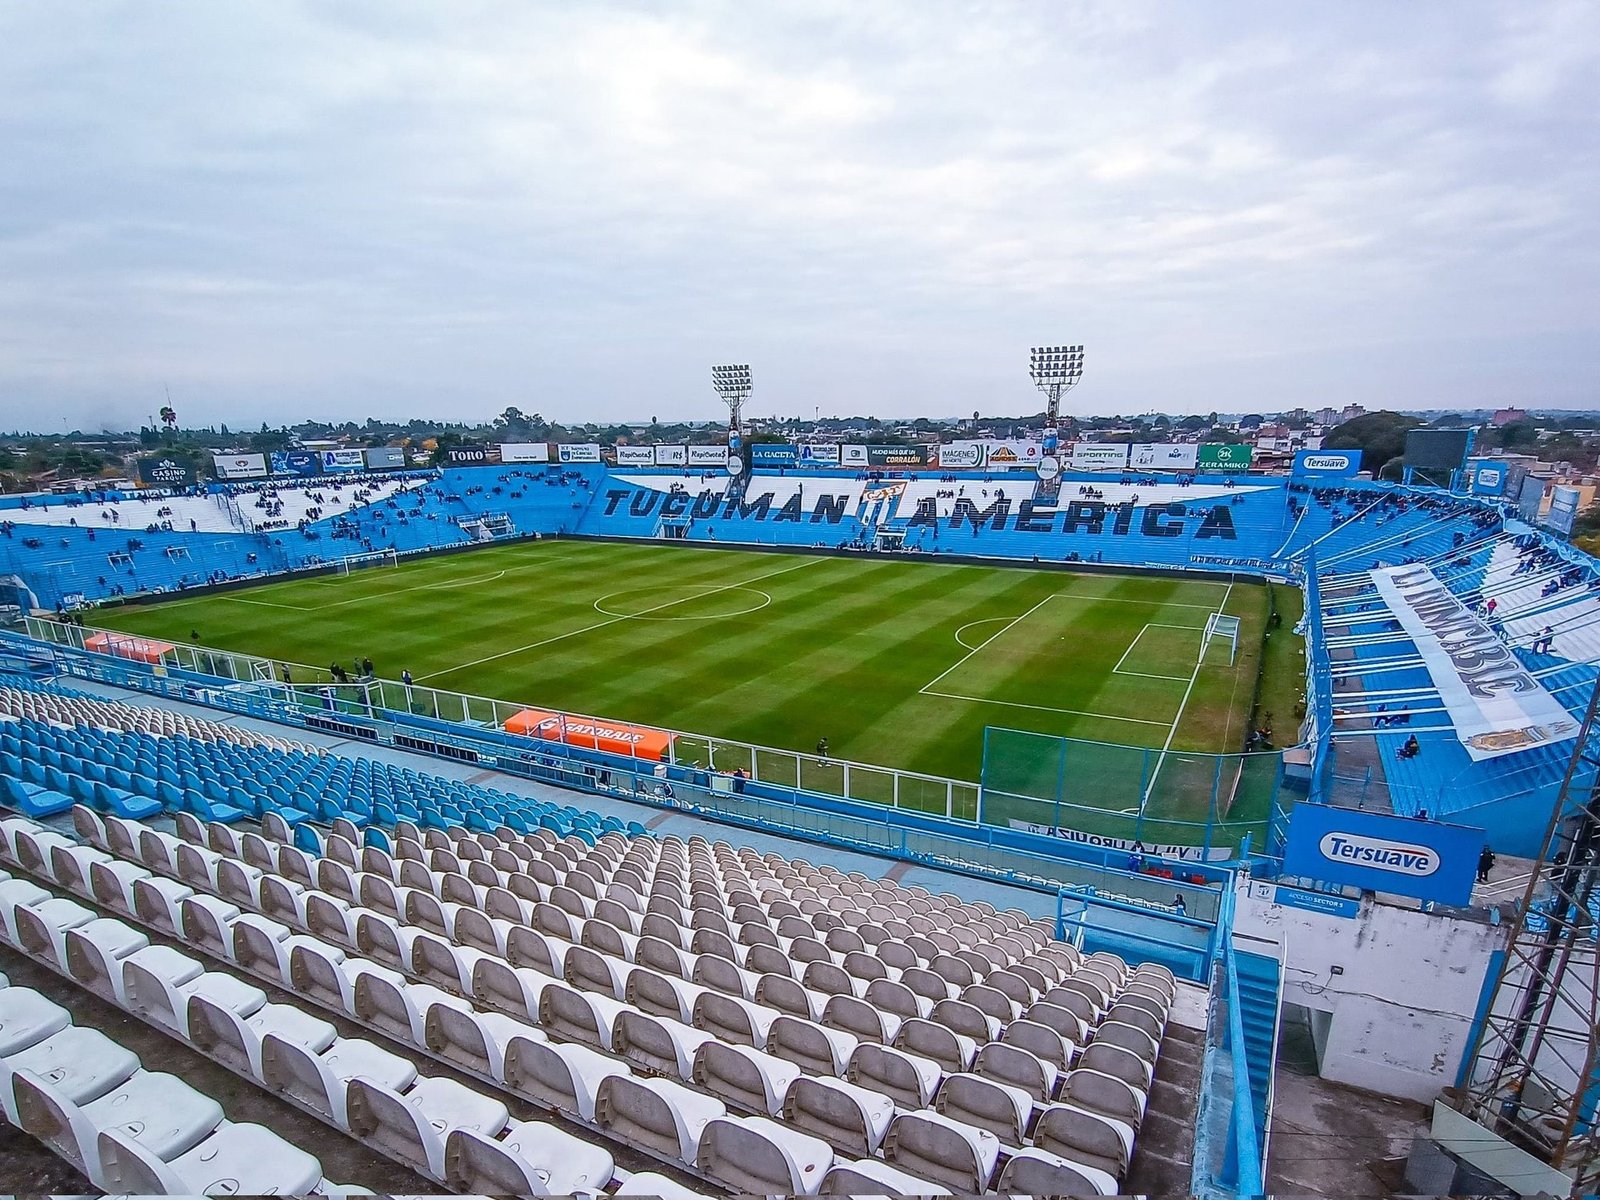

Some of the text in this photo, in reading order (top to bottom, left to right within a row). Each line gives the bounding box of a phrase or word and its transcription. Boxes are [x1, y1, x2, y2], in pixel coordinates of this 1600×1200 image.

[449, 450, 484, 461] TORO
[752, 451, 796, 459] LA GACETA
[886, 455, 921, 463] CORRALÓN
[1307, 457, 1347, 469] Tersuave
[152, 469, 186, 477] CASINO
[602, 489, 1237, 540] TUCUMAN AMERICA
[562, 722, 645, 743] GATORADE
[1330, 836, 1430, 871] Tersuave
[1313, 897, 1338, 907] SECTOR
